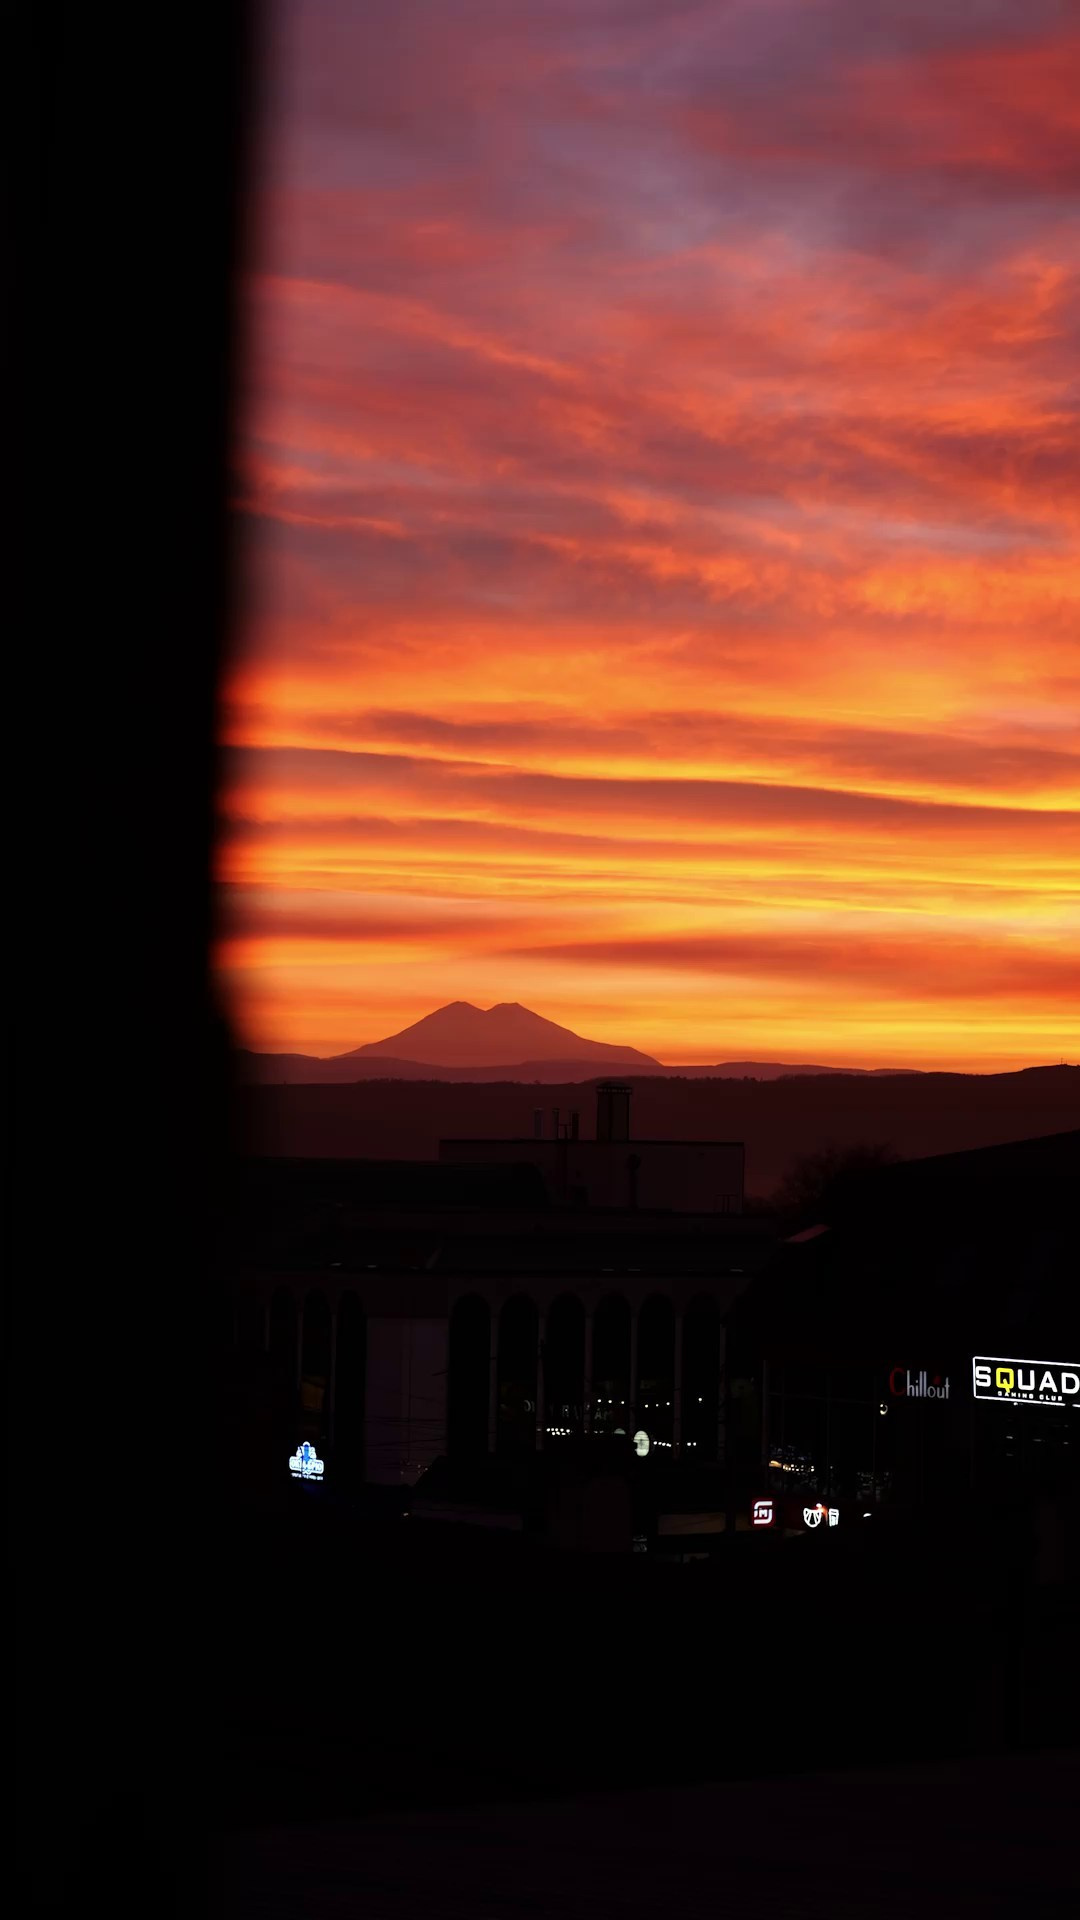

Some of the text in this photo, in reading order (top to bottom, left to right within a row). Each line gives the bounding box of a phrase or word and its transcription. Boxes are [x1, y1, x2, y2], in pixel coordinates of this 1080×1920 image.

[889, 1368, 950, 1400] Chillout
[975, 1365, 1080, 1395] SQUAD
[998, 1391, 1063, 1402] GAMING CLUB
